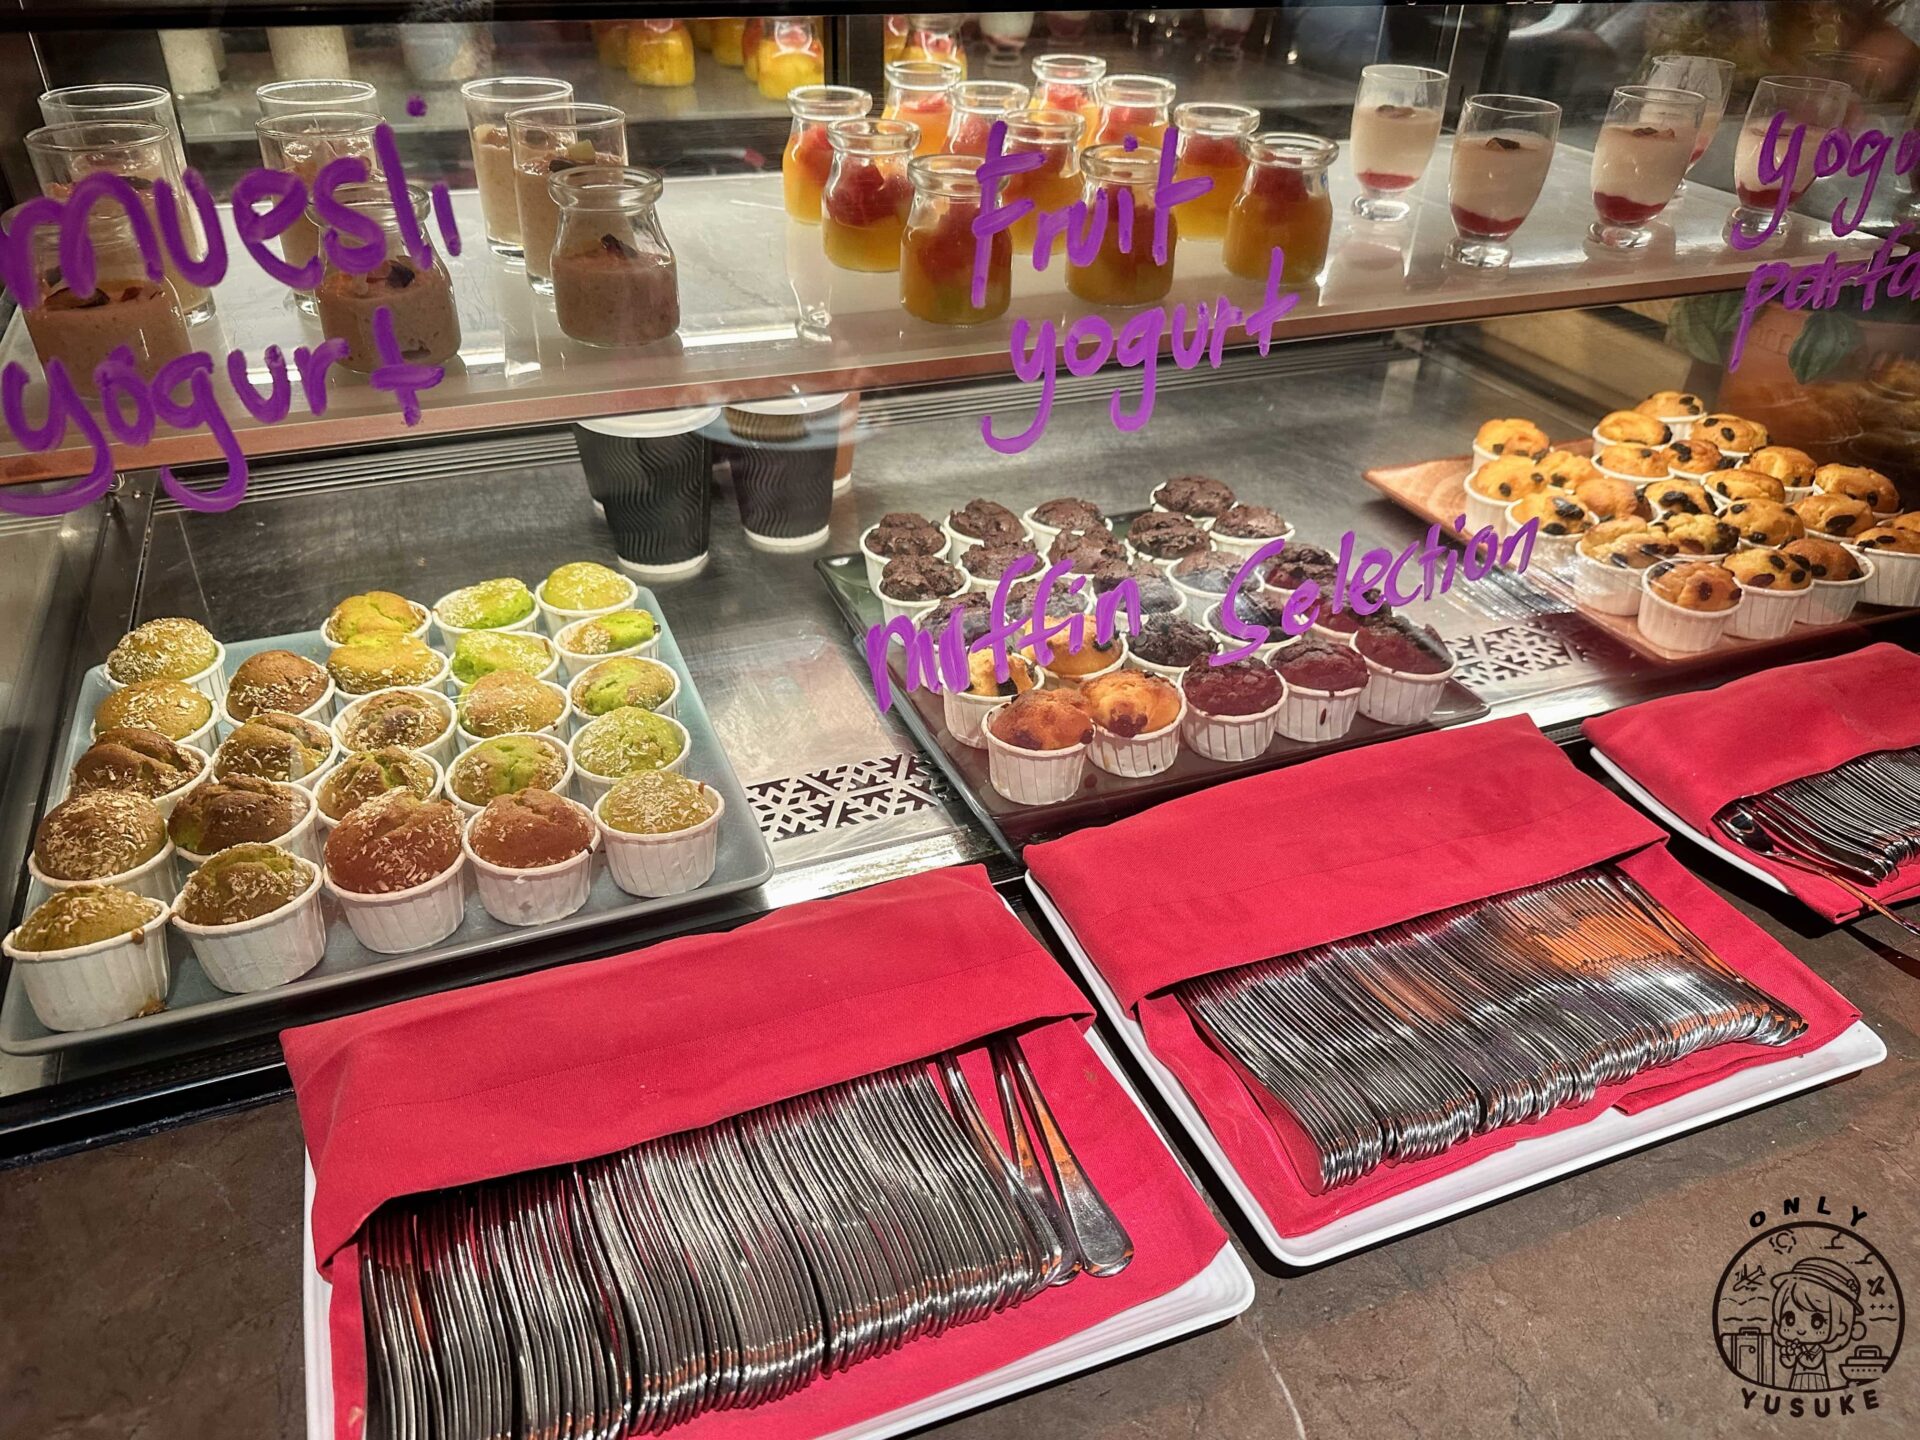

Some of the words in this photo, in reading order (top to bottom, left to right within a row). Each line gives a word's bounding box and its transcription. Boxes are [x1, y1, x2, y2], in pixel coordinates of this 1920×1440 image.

[0, 98, 463, 308] muesli
[0, 306, 446, 516] yogurt
[980, 246, 1299, 455] yogurt
[865, 553, 1142, 714] muffin
